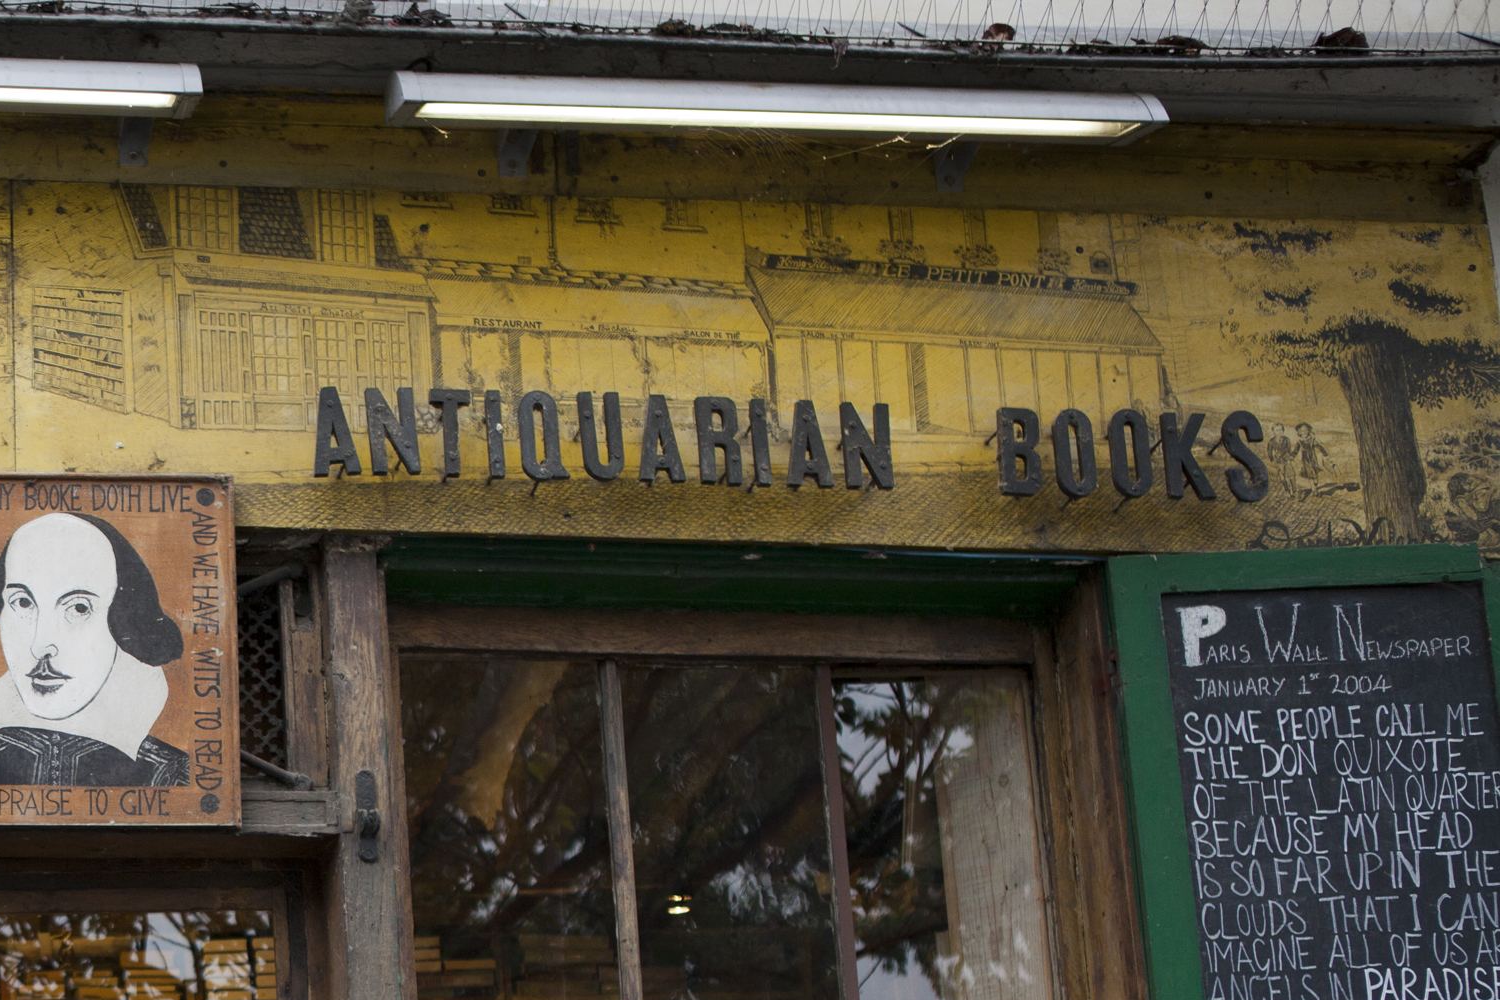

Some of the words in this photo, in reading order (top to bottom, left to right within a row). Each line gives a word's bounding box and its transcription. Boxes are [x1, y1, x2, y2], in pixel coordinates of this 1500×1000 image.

[883, 264, 912, 279] LE
[926, 266, 988, 285] PETIT
[998, 272, 1046, 289] PONT
[473, 317, 543, 330] RESTAURANT
[313, 386, 895, 489] ANTIQUARIAN
[996, 406, 1269, 503] BOOKS
[24, 483, 82, 512] BOOKE
[92, 484, 142, 513] DOTH
[149, 485, 194, 513] LIVE
[192, 511, 218, 546] AND
[193, 552, 218, 579] WE
[192, 584, 220, 636] HAVE
[1254, 602, 1328, 664] WALL
[1332, 602, 1472, 661] NEWSPAPER
[193, 649, 221, 699] WITS
[1194, 677, 1286, 700] JANUARY
[1329, 674, 1392, 695] 2004
[194, 707, 222, 731] TO
[1183, 710, 1266, 747] SOME
[1276, 705, 1365, 742] PEOPLE
[1375, 702, 1436, 737] CALL
[1446, 702, 1484, 736] ME
[194, 738, 223, 791] READ
[1183, 745, 1249, 780] THE
[1260, 739, 1318, 778] DON
[1333, 738, 1466, 778] QUIXOTE
[84, 790, 109, 816] TO
[119, 789, 170, 816] GIVE
[1193, 782, 1228, 819] OF
[1239, 778, 1298, 816] THE
[1308, 774, 1396, 815] LATIN
[1191, 816, 1329, 860] BECAUSE
[1343, 812, 1380, 852] MY
[1394, 811, 1474, 851] HEAD
[1195, 858, 1223, 899] IS
[1230, 858, 1266, 897] SO
[1273, 855, 1338, 895] FAR
[1344, 851, 1384, 891] UP
[1390, 851, 1421, 889] IN
[1435, 850, 1500, 889] THE
[1201, 899, 1307, 940] CLOUDS
[1318, 895, 1399, 934] THAT
[1409, 893, 1422, 932] I
[1437, 891, 1500, 932] CAN
